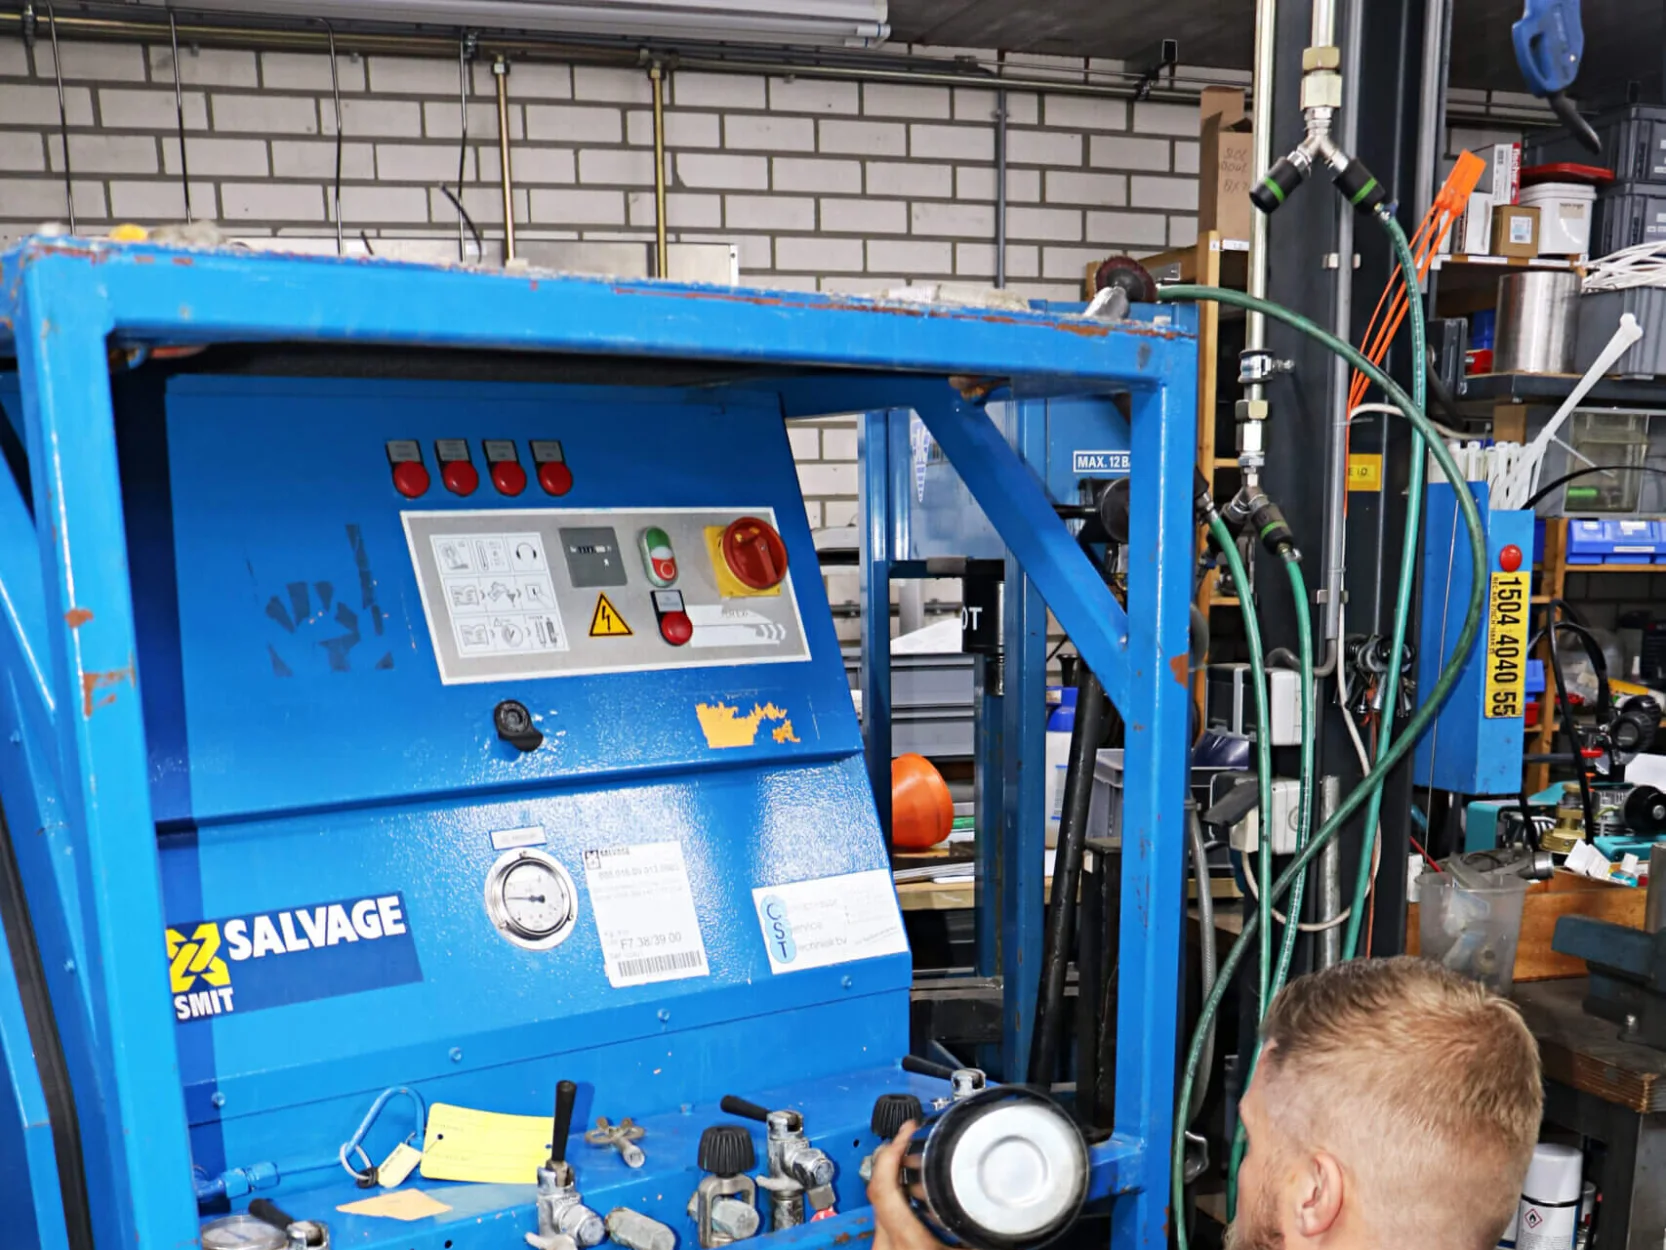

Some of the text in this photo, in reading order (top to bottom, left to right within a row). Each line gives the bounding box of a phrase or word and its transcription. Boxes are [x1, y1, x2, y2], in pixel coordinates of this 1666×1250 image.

[1077, 455, 1108, 469] MAX.
[1491, 577, 1522, 717] 1504 4040 55
[223, 895, 407, 962] SALVAGE
[174, 987, 235, 1020] SMIT
